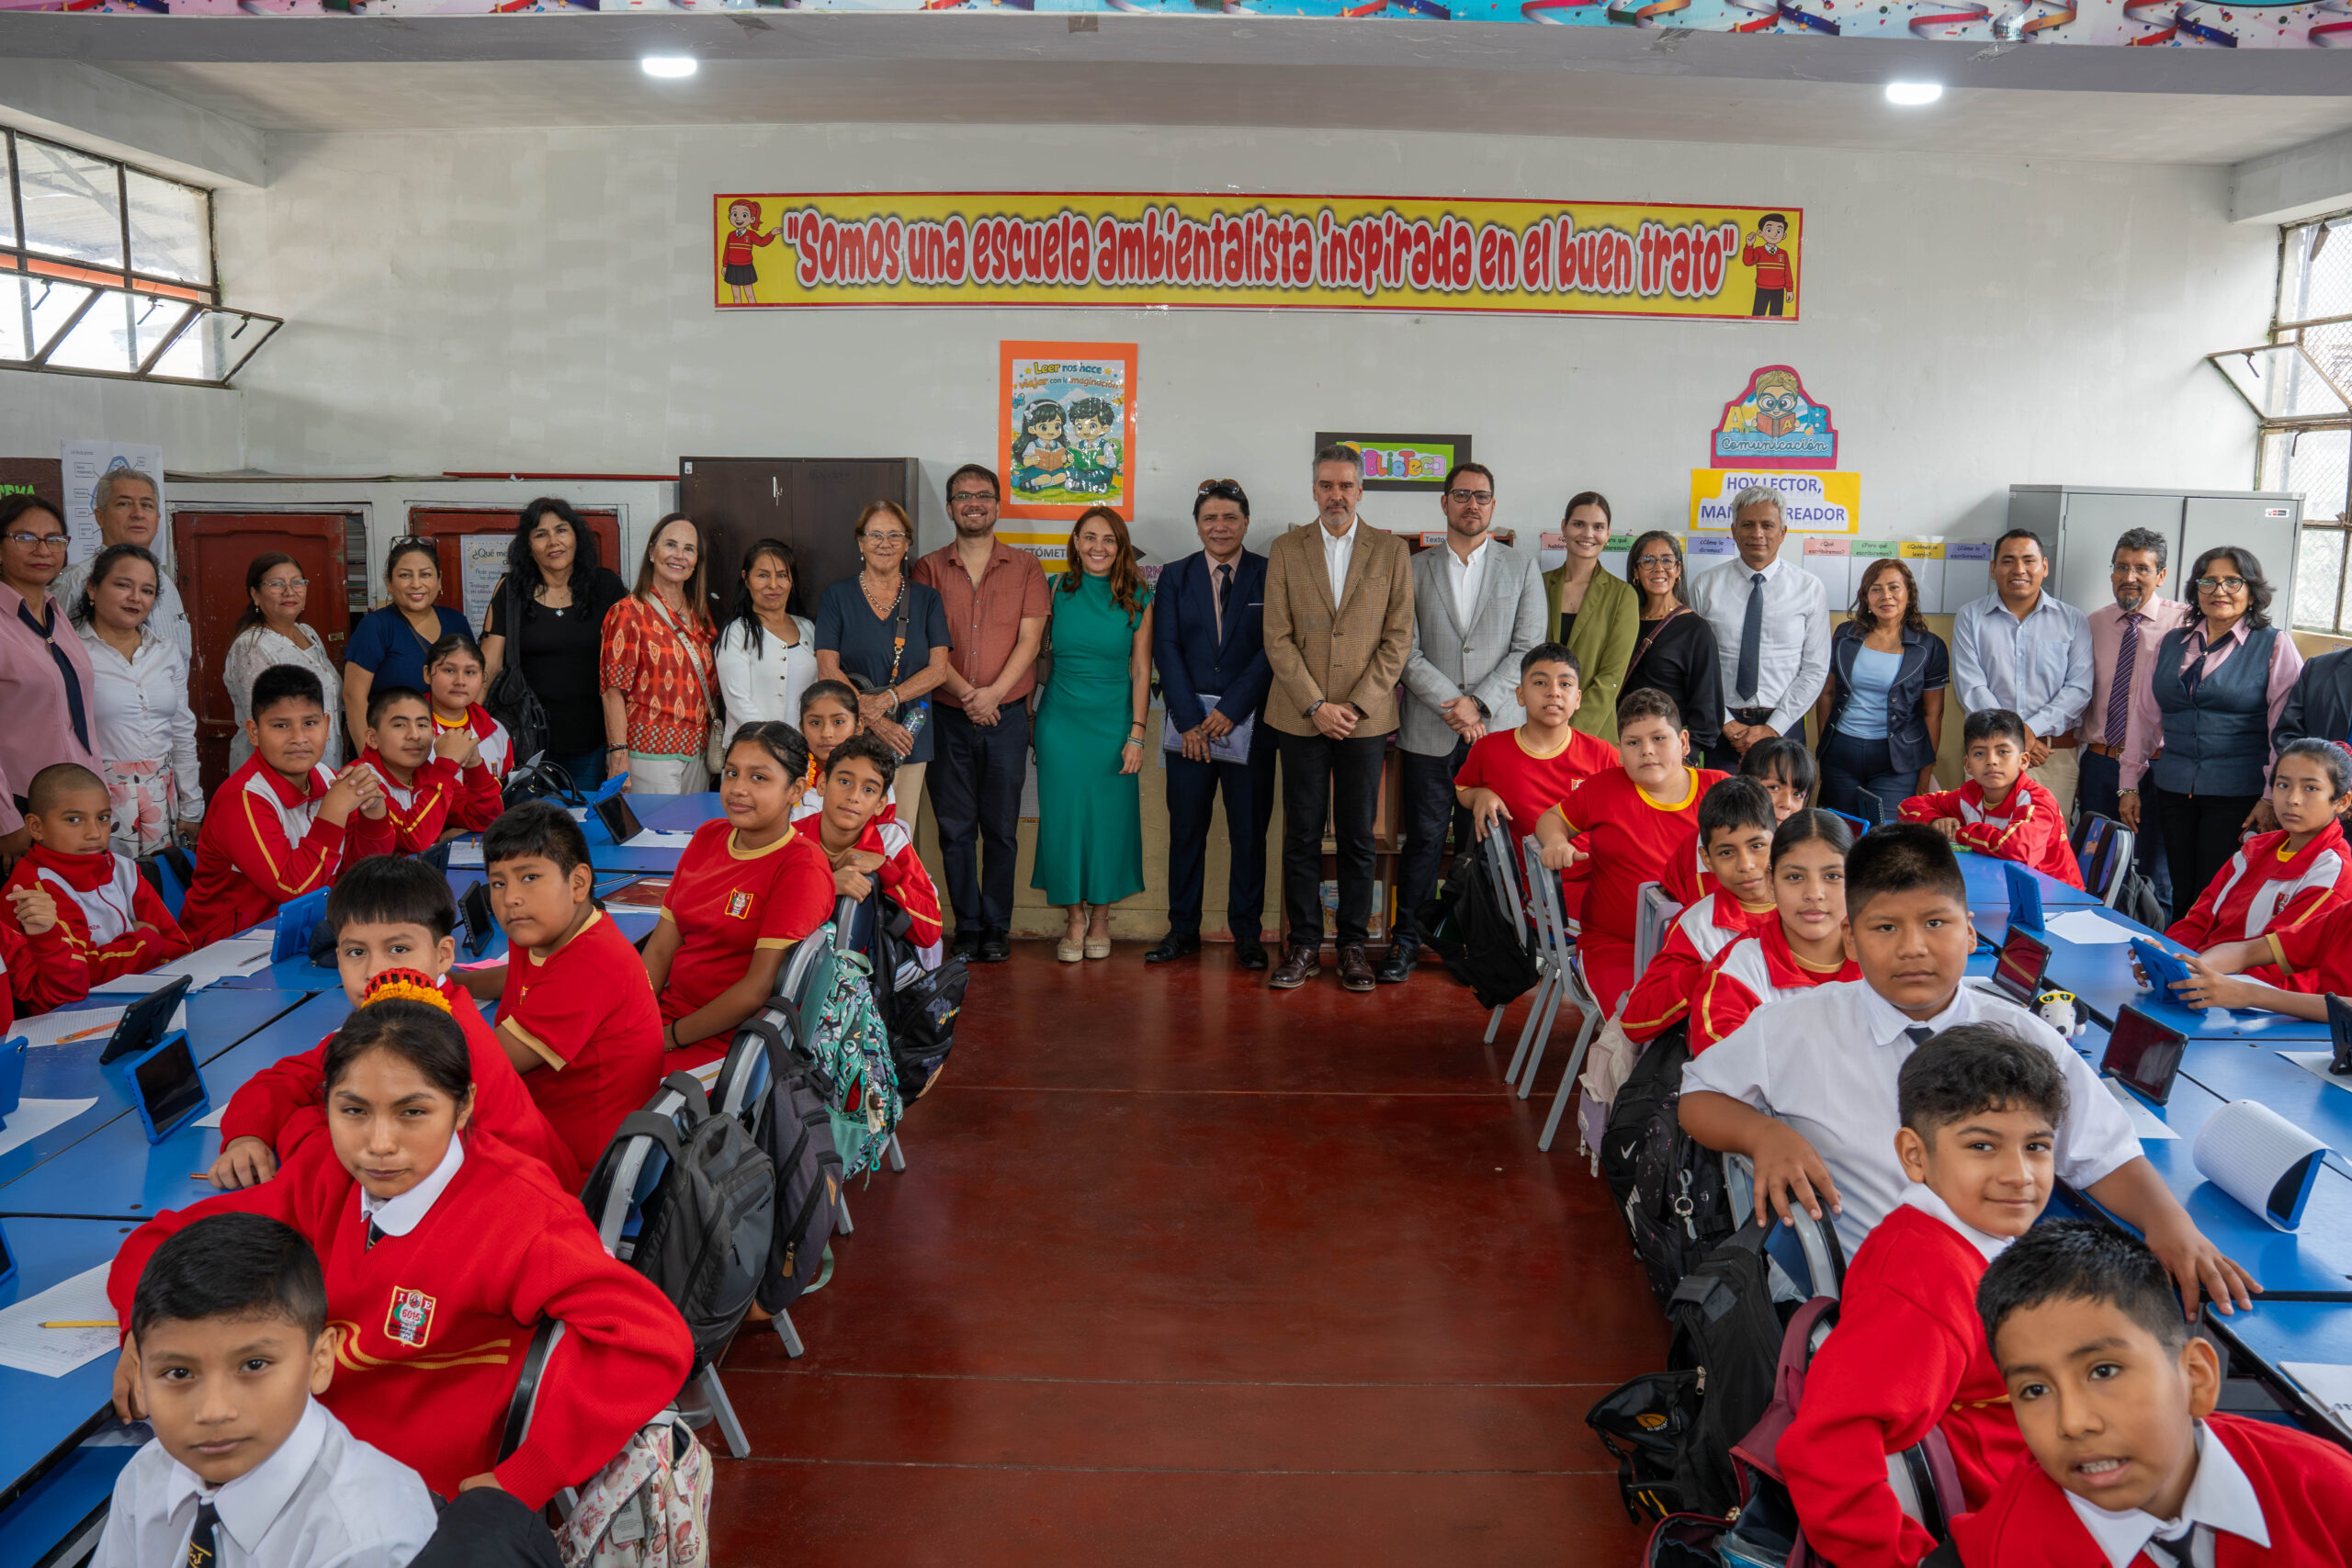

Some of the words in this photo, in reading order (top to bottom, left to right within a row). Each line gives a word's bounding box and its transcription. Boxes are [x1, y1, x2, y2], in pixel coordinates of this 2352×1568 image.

[786, 211, 900, 285] "Somos
[906, 217, 961, 285] una
[971, 213, 1092, 284] escuela
[1101, 207, 1312, 286] ambientalista
[1319, 211, 1469, 292] inspirada
[1479, 224, 1519, 291] en
[1522, 219, 1555, 290] el
[1559, 217, 1634, 294] buen
[1639, 220, 1735, 297] trato"
[1034, 362, 1060, 375] Leer
[1079, 362, 1102, 374] hace
[1018, 377, 1048, 389] viajar
[1721, 437, 1828, 451] Comunicación
[1726, 477, 1759, 490] HOY
[472, 548, 494, 559] ¿Qué
[401, 1309, 421, 1322] 6015
